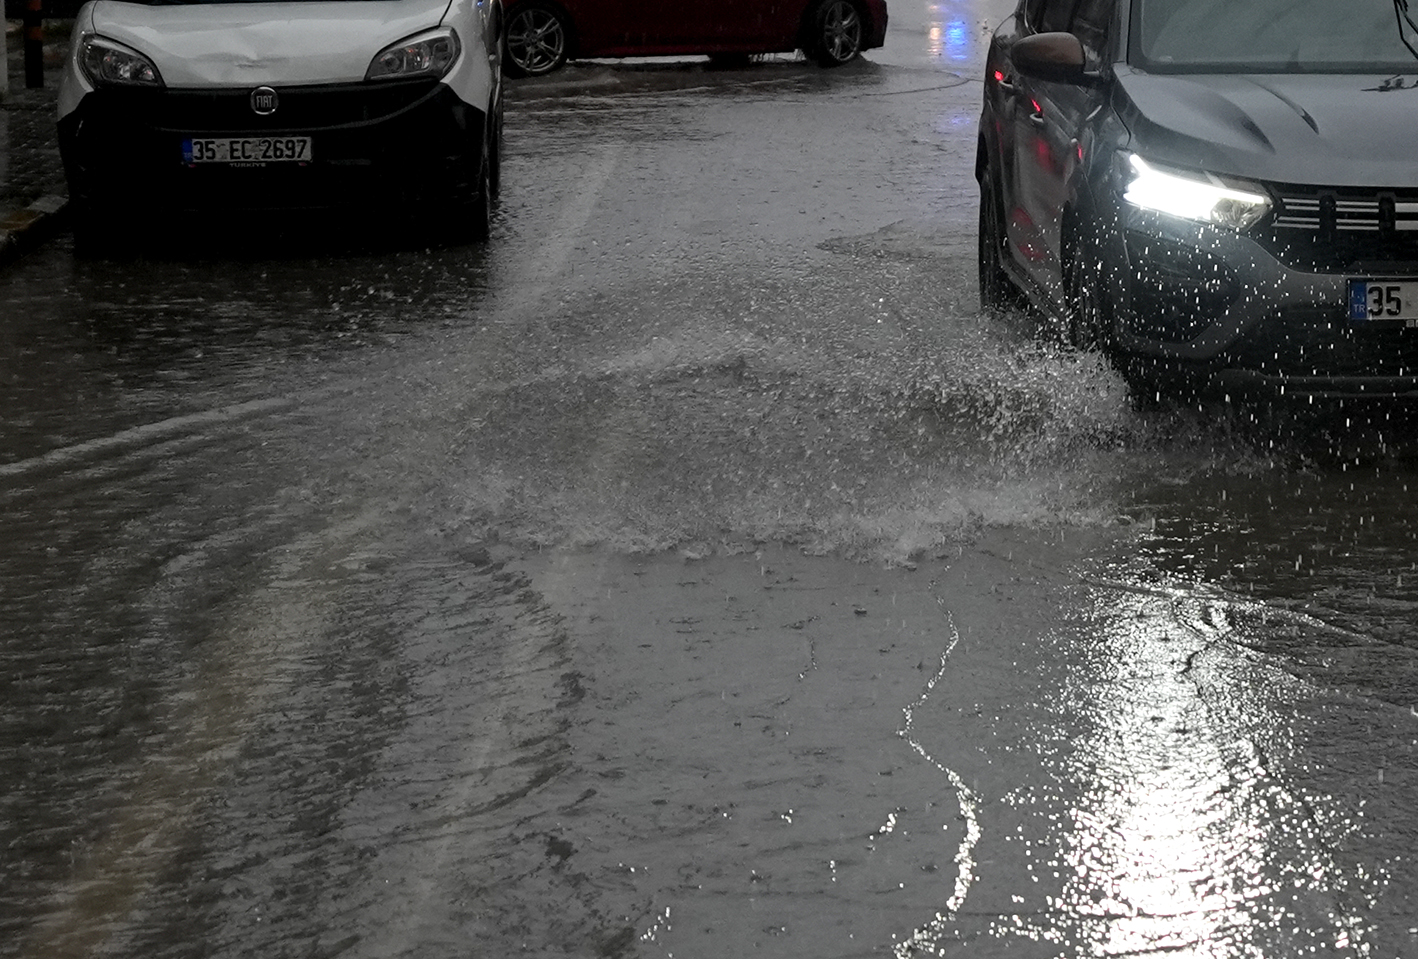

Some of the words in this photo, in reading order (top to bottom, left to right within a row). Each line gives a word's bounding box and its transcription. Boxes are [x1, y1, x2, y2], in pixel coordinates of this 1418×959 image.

[256, 96, 272, 108] FIAT
[194, 141, 215, 160] 35
[230, 140, 252, 160] EC
[260, 140, 307, 159] 2697
[1353, 304, 1366, 313] TR
[1368, 286, 1401, 315] 35
